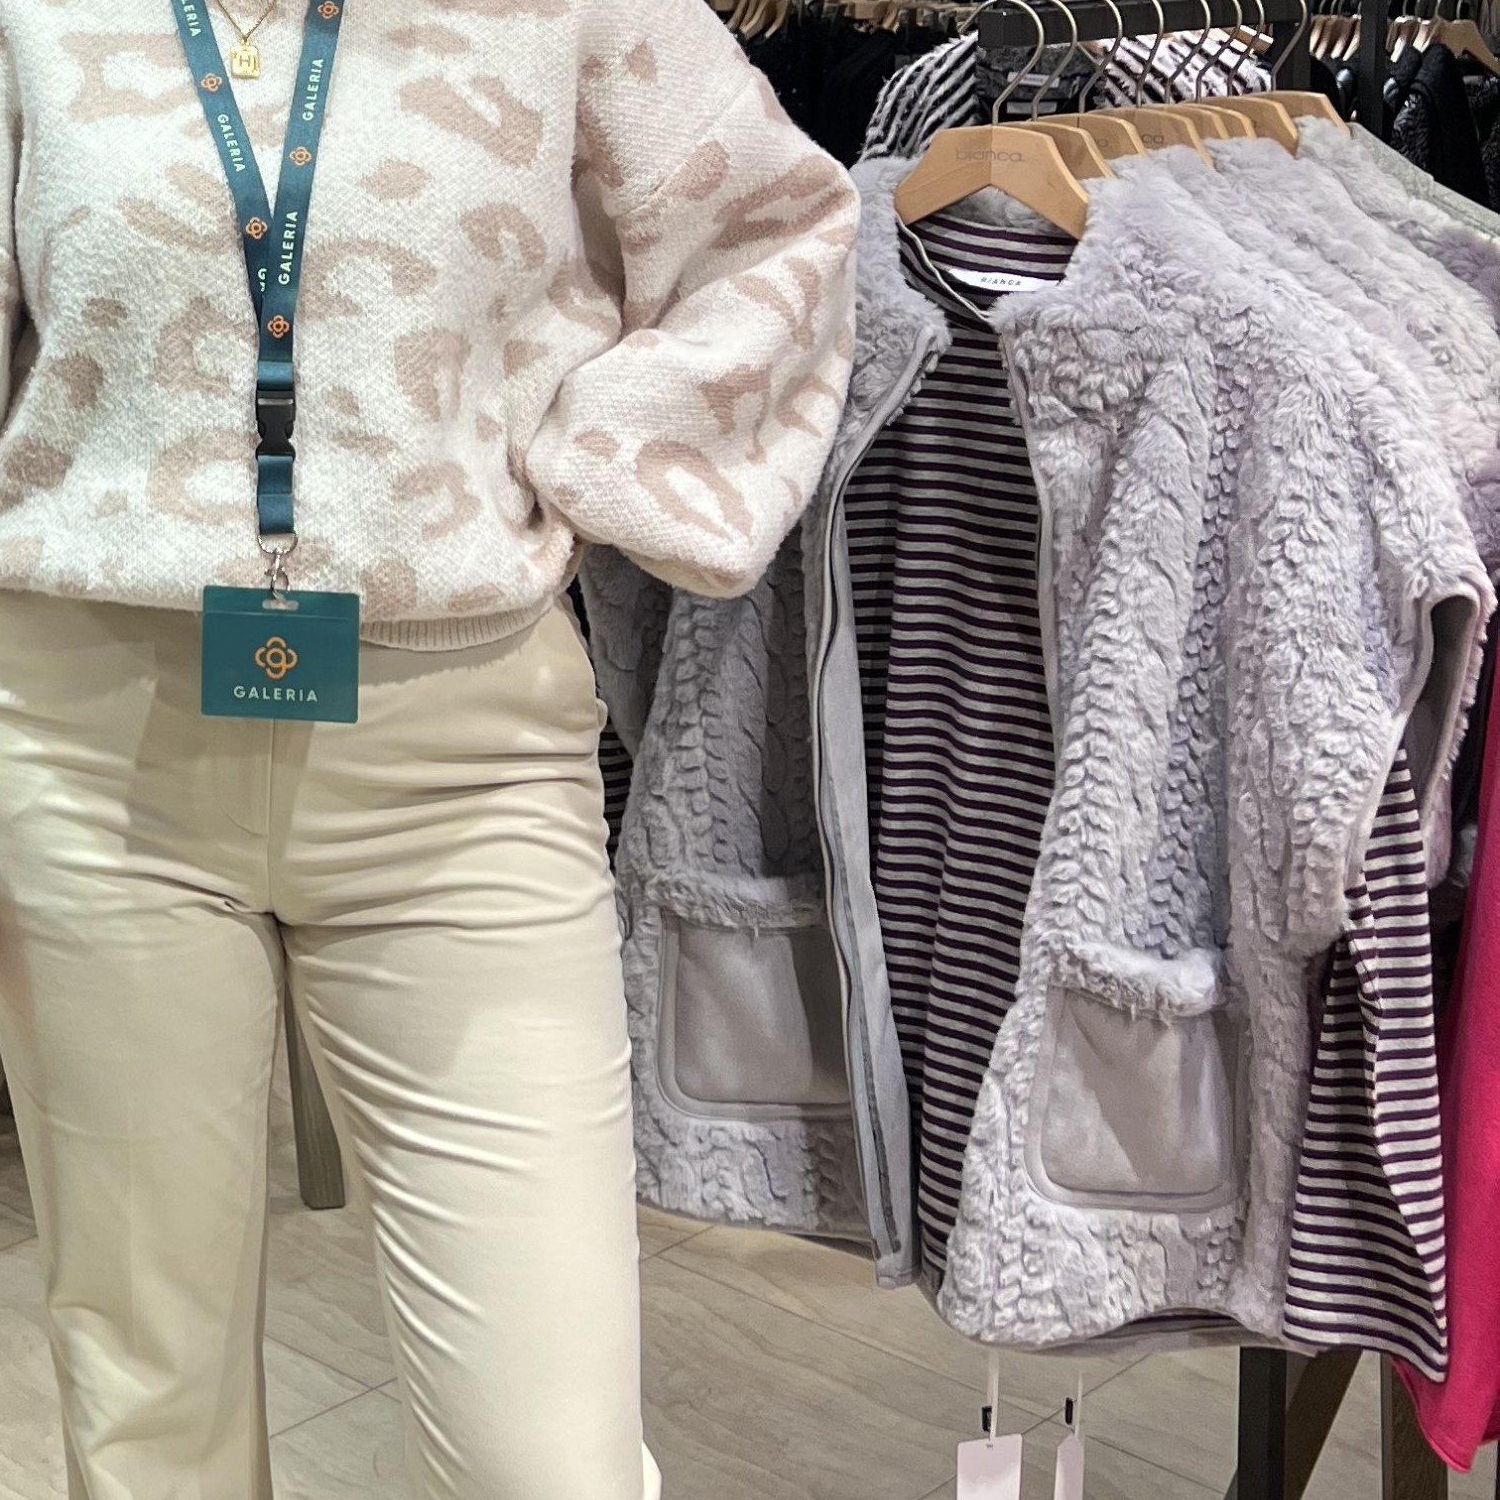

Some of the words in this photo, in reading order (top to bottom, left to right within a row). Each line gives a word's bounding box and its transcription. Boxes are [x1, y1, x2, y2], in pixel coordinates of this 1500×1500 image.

[302, 58, 325, 121] GALERIA
[217, 113, 246, 173] GALERIA
[278, 210, 299, 285] GALERIA
[233, 685, 318, 703] GALERIA
